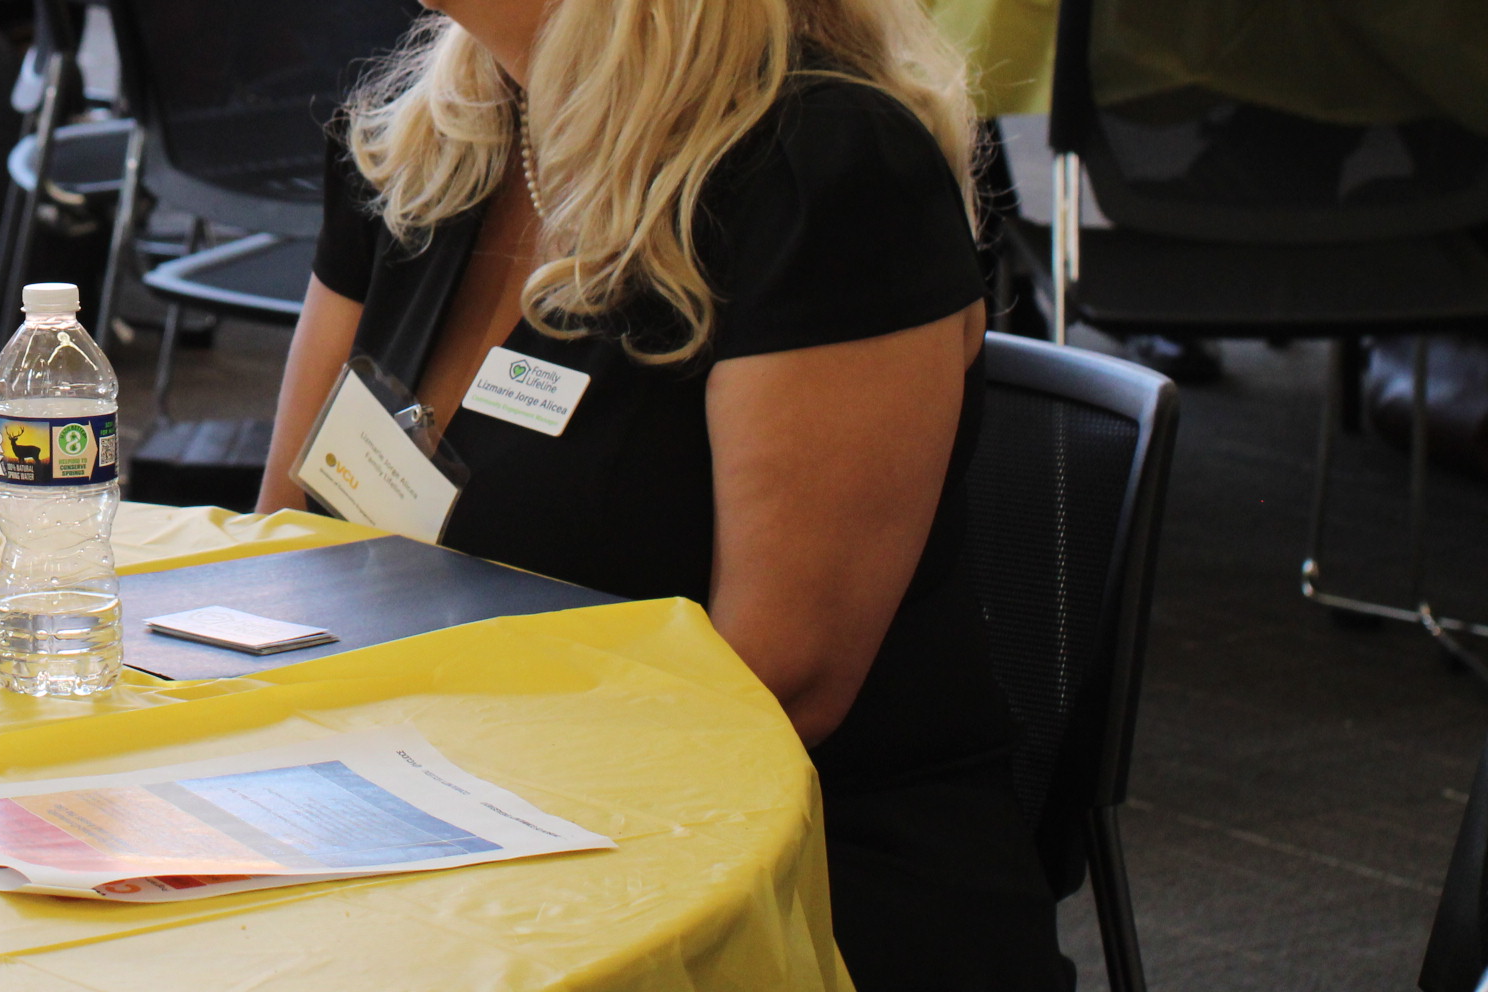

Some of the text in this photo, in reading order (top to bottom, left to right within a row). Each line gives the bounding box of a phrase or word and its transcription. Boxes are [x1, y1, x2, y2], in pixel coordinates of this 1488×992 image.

[532, 366, 561, 384] Family
[476, 379, 568, 416] Lizmarie Jorge Alicea
